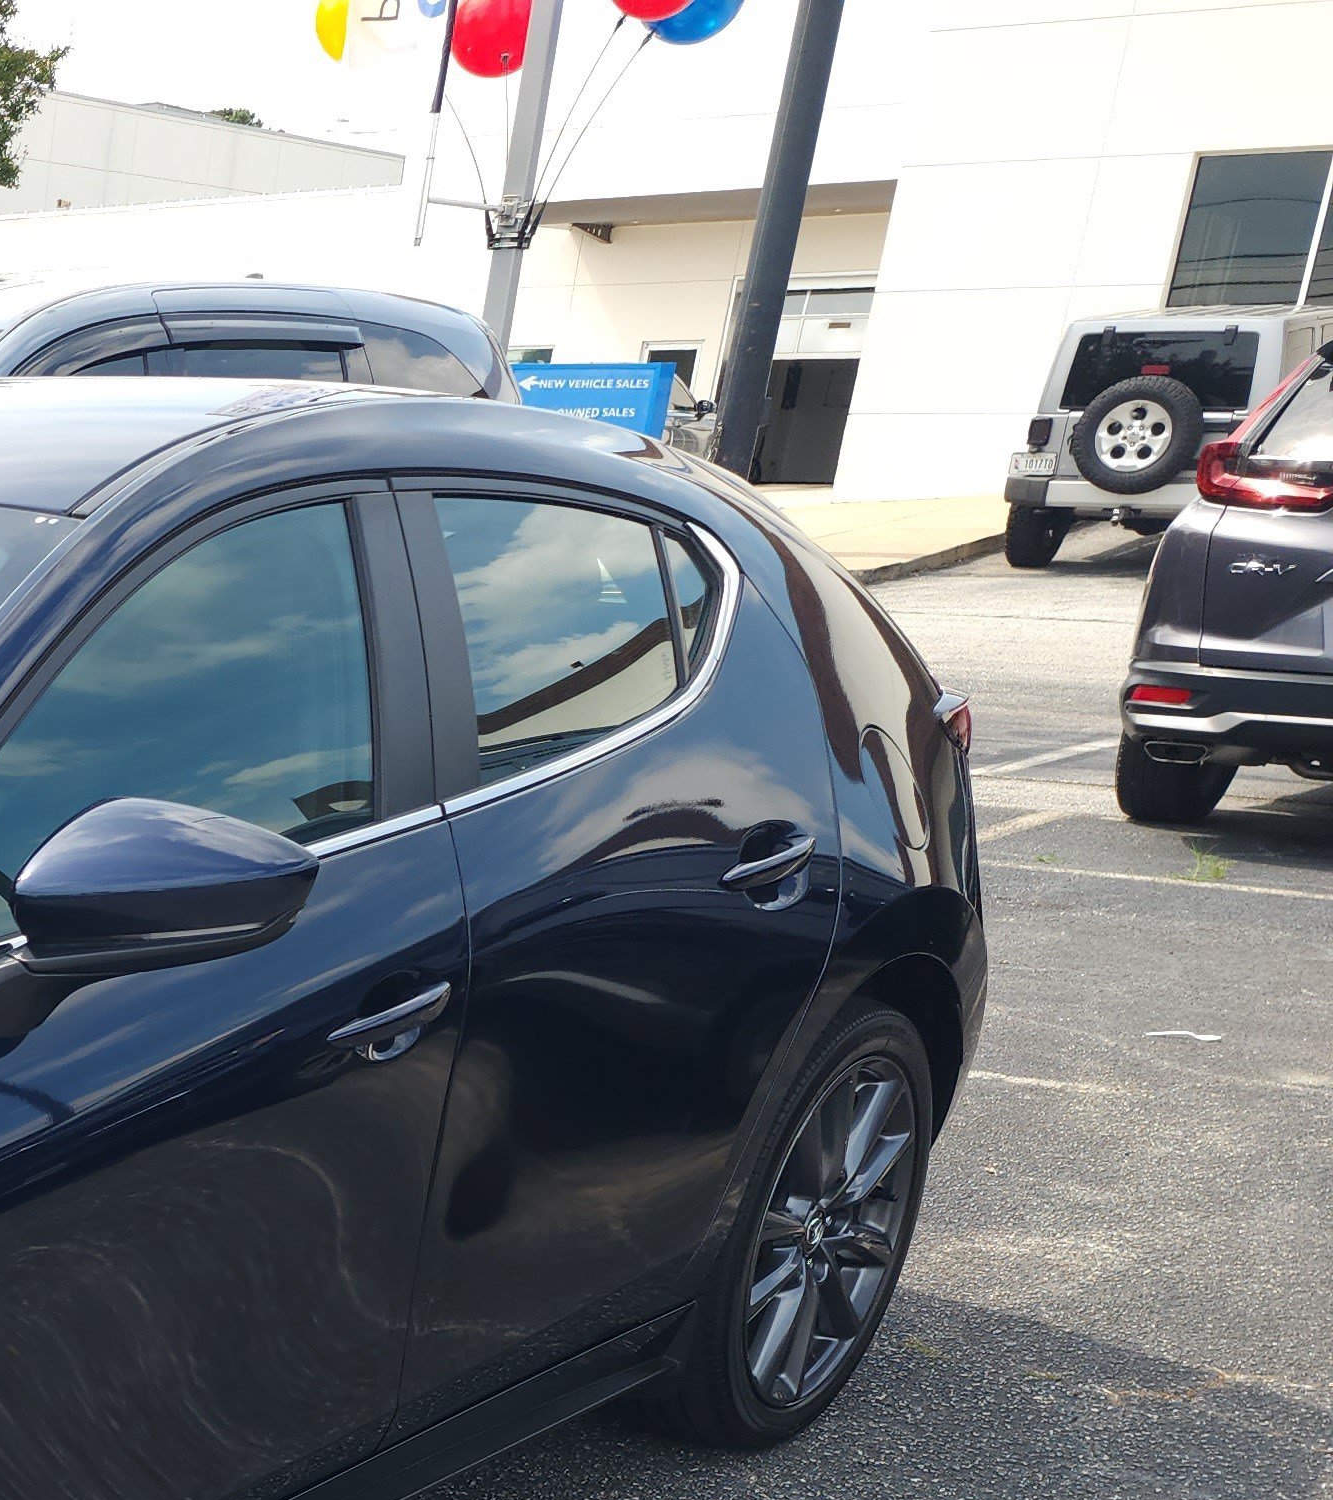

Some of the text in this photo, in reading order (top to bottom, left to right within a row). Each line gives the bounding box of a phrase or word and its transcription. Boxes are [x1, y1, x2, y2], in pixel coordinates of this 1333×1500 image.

[539, 379, 650, 389] NEW VEHICLE SALES
[601, 407, 636, 417] SALES
[1228, 561, 1296, 576] CR-V
